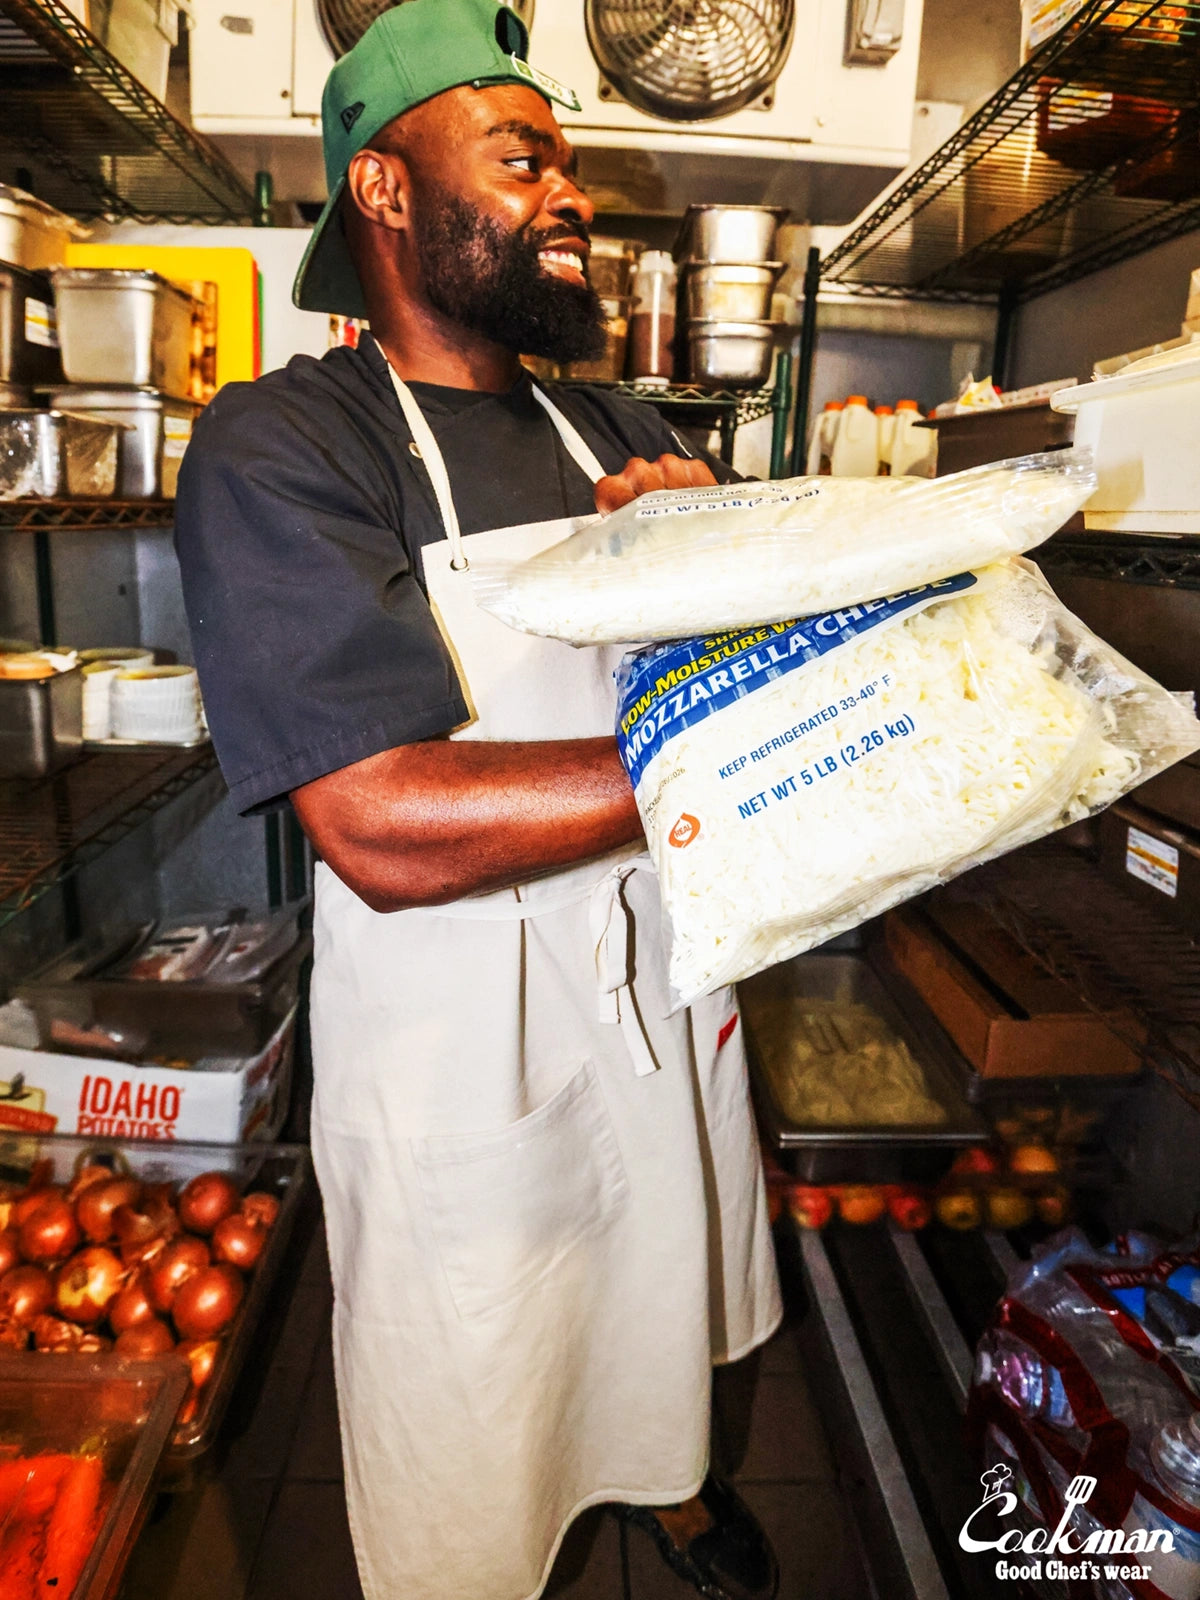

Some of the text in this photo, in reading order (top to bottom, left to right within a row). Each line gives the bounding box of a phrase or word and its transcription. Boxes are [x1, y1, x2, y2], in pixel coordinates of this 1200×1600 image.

[621, 628, 771, 735] LOW-MOISTURE
[625, 631, 811, 768] MOZZARELLA
[718, 755, 747, 780] KEEP
[750, 705, 839, 763] REFRIGERATED
[882, 674, 892, 687] F
[737, 713, 916, 819] NET WT 5 LB (2.26 kg)
[79, 1074, 181, 1121] IDAHO
